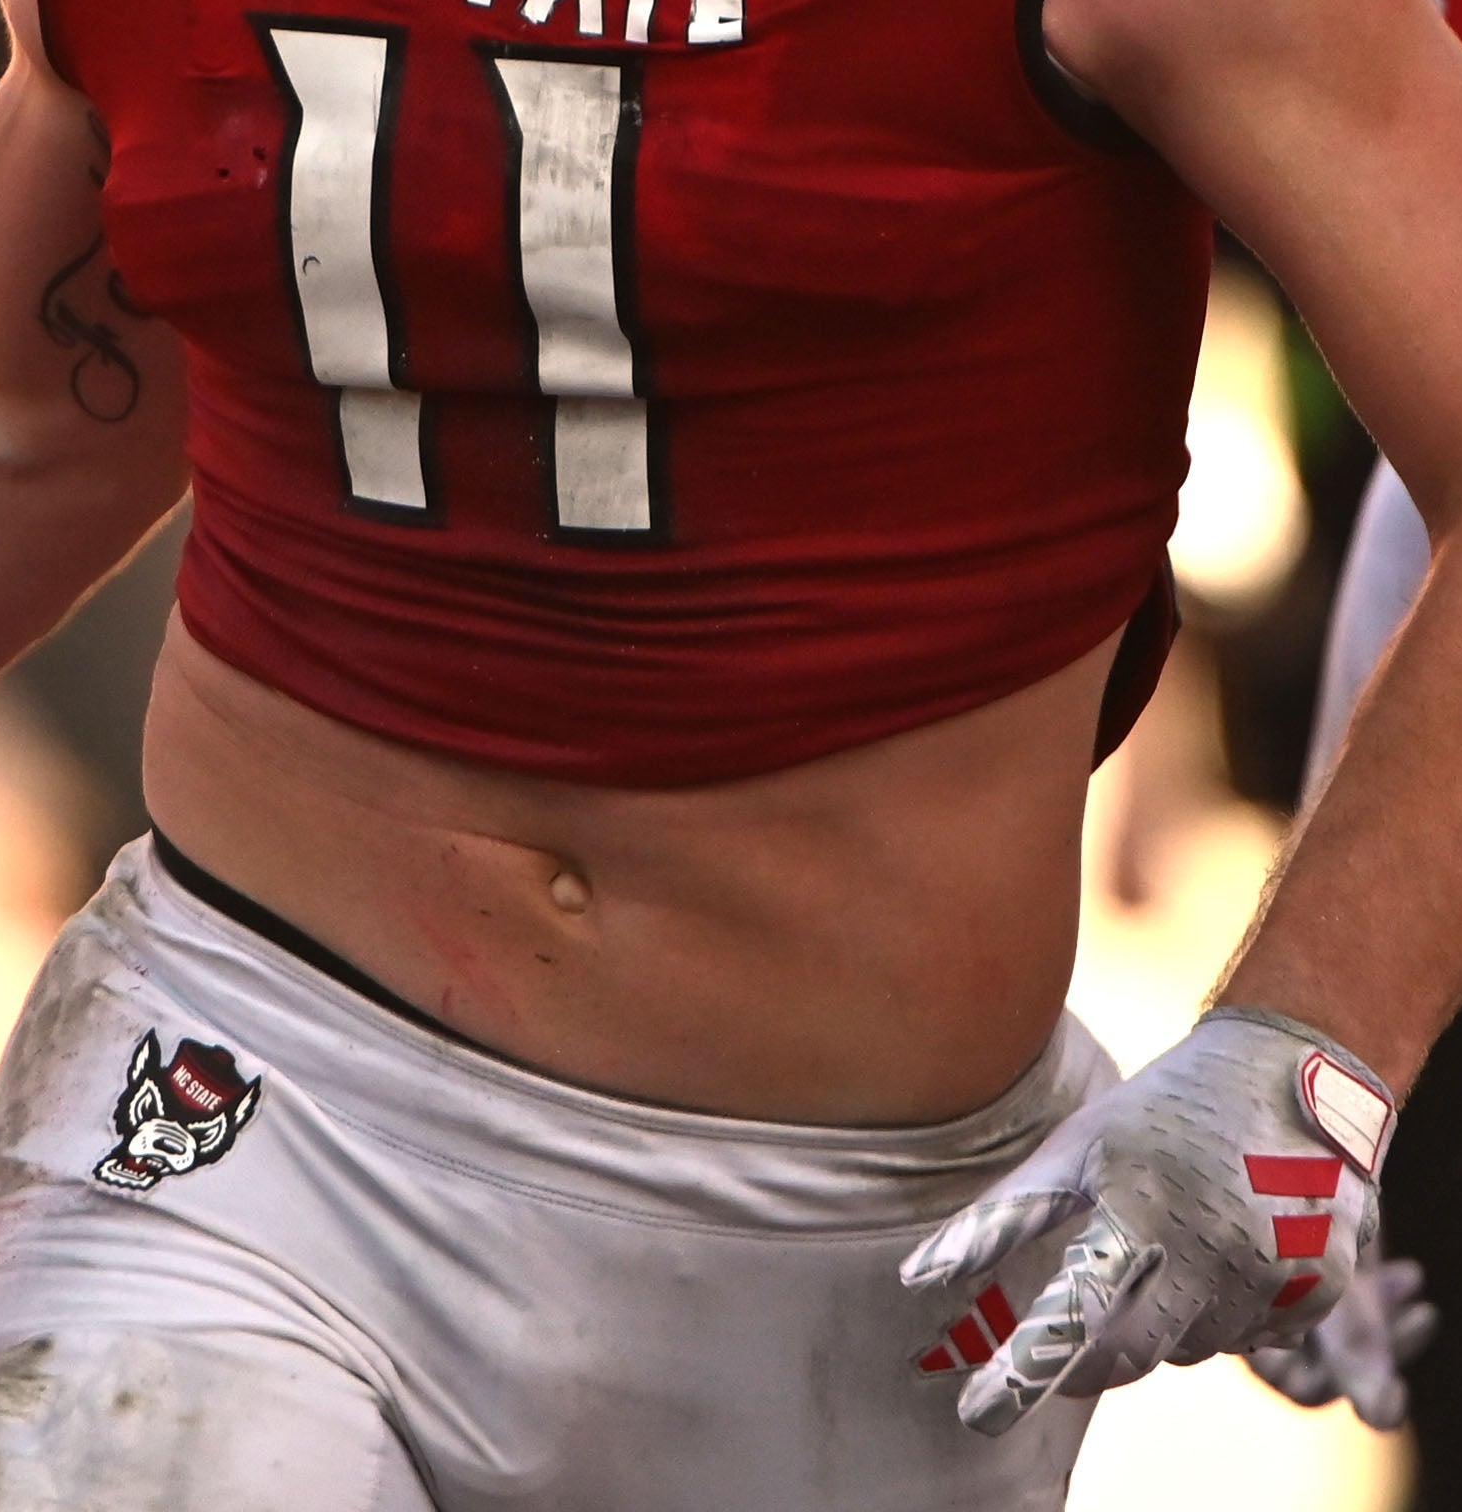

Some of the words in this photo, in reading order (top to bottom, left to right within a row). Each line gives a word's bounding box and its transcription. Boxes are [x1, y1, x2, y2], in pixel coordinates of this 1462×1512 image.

[259, 20, 659, 536] 11
[172, 1064, 192, 1088] NC
[185, 1079, 223, 1112] STATE
